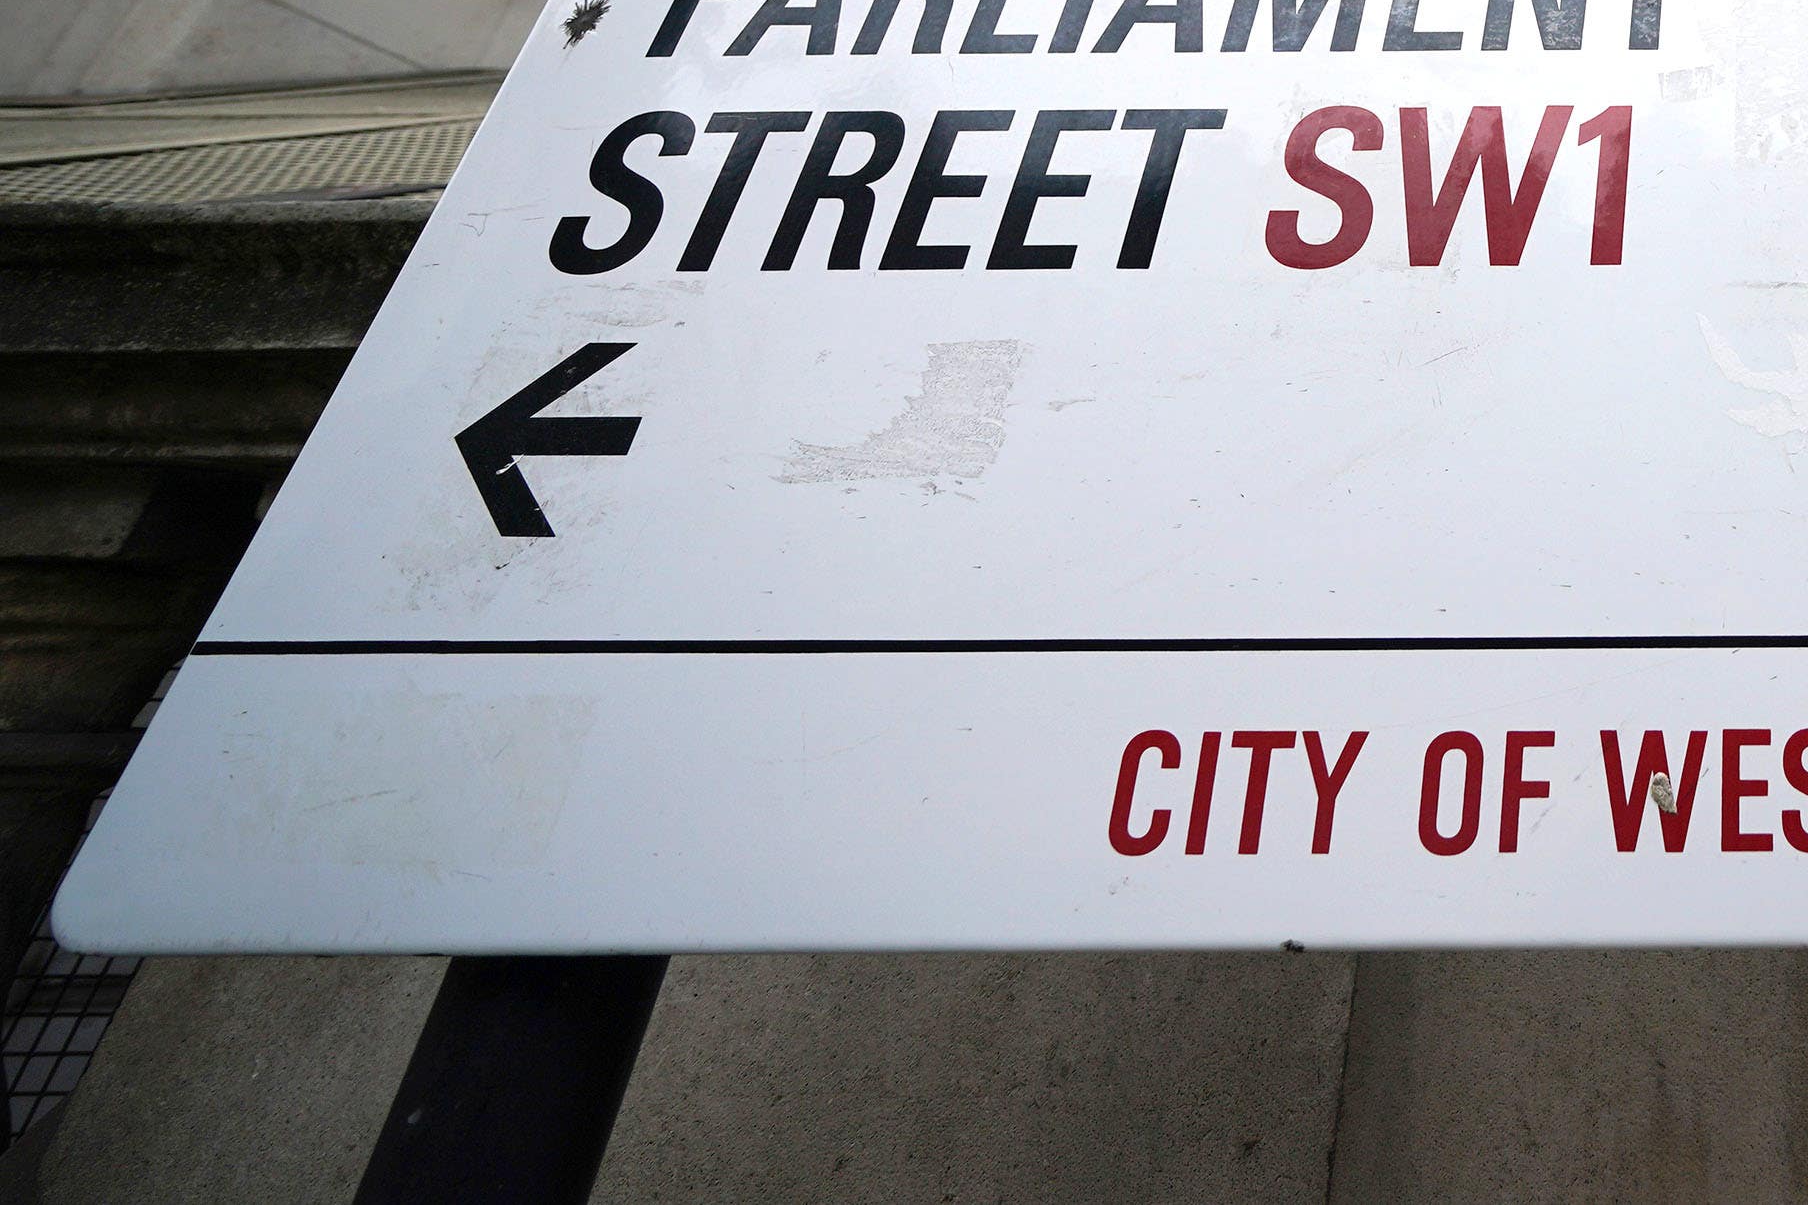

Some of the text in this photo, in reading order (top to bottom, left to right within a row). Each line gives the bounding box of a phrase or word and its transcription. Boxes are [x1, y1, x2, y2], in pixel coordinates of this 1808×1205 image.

[549, 105, 1632, 275] STREET SW1
[1109, 729, 1369, 857] CITY
[1419, 730, 1555, 857] OF
